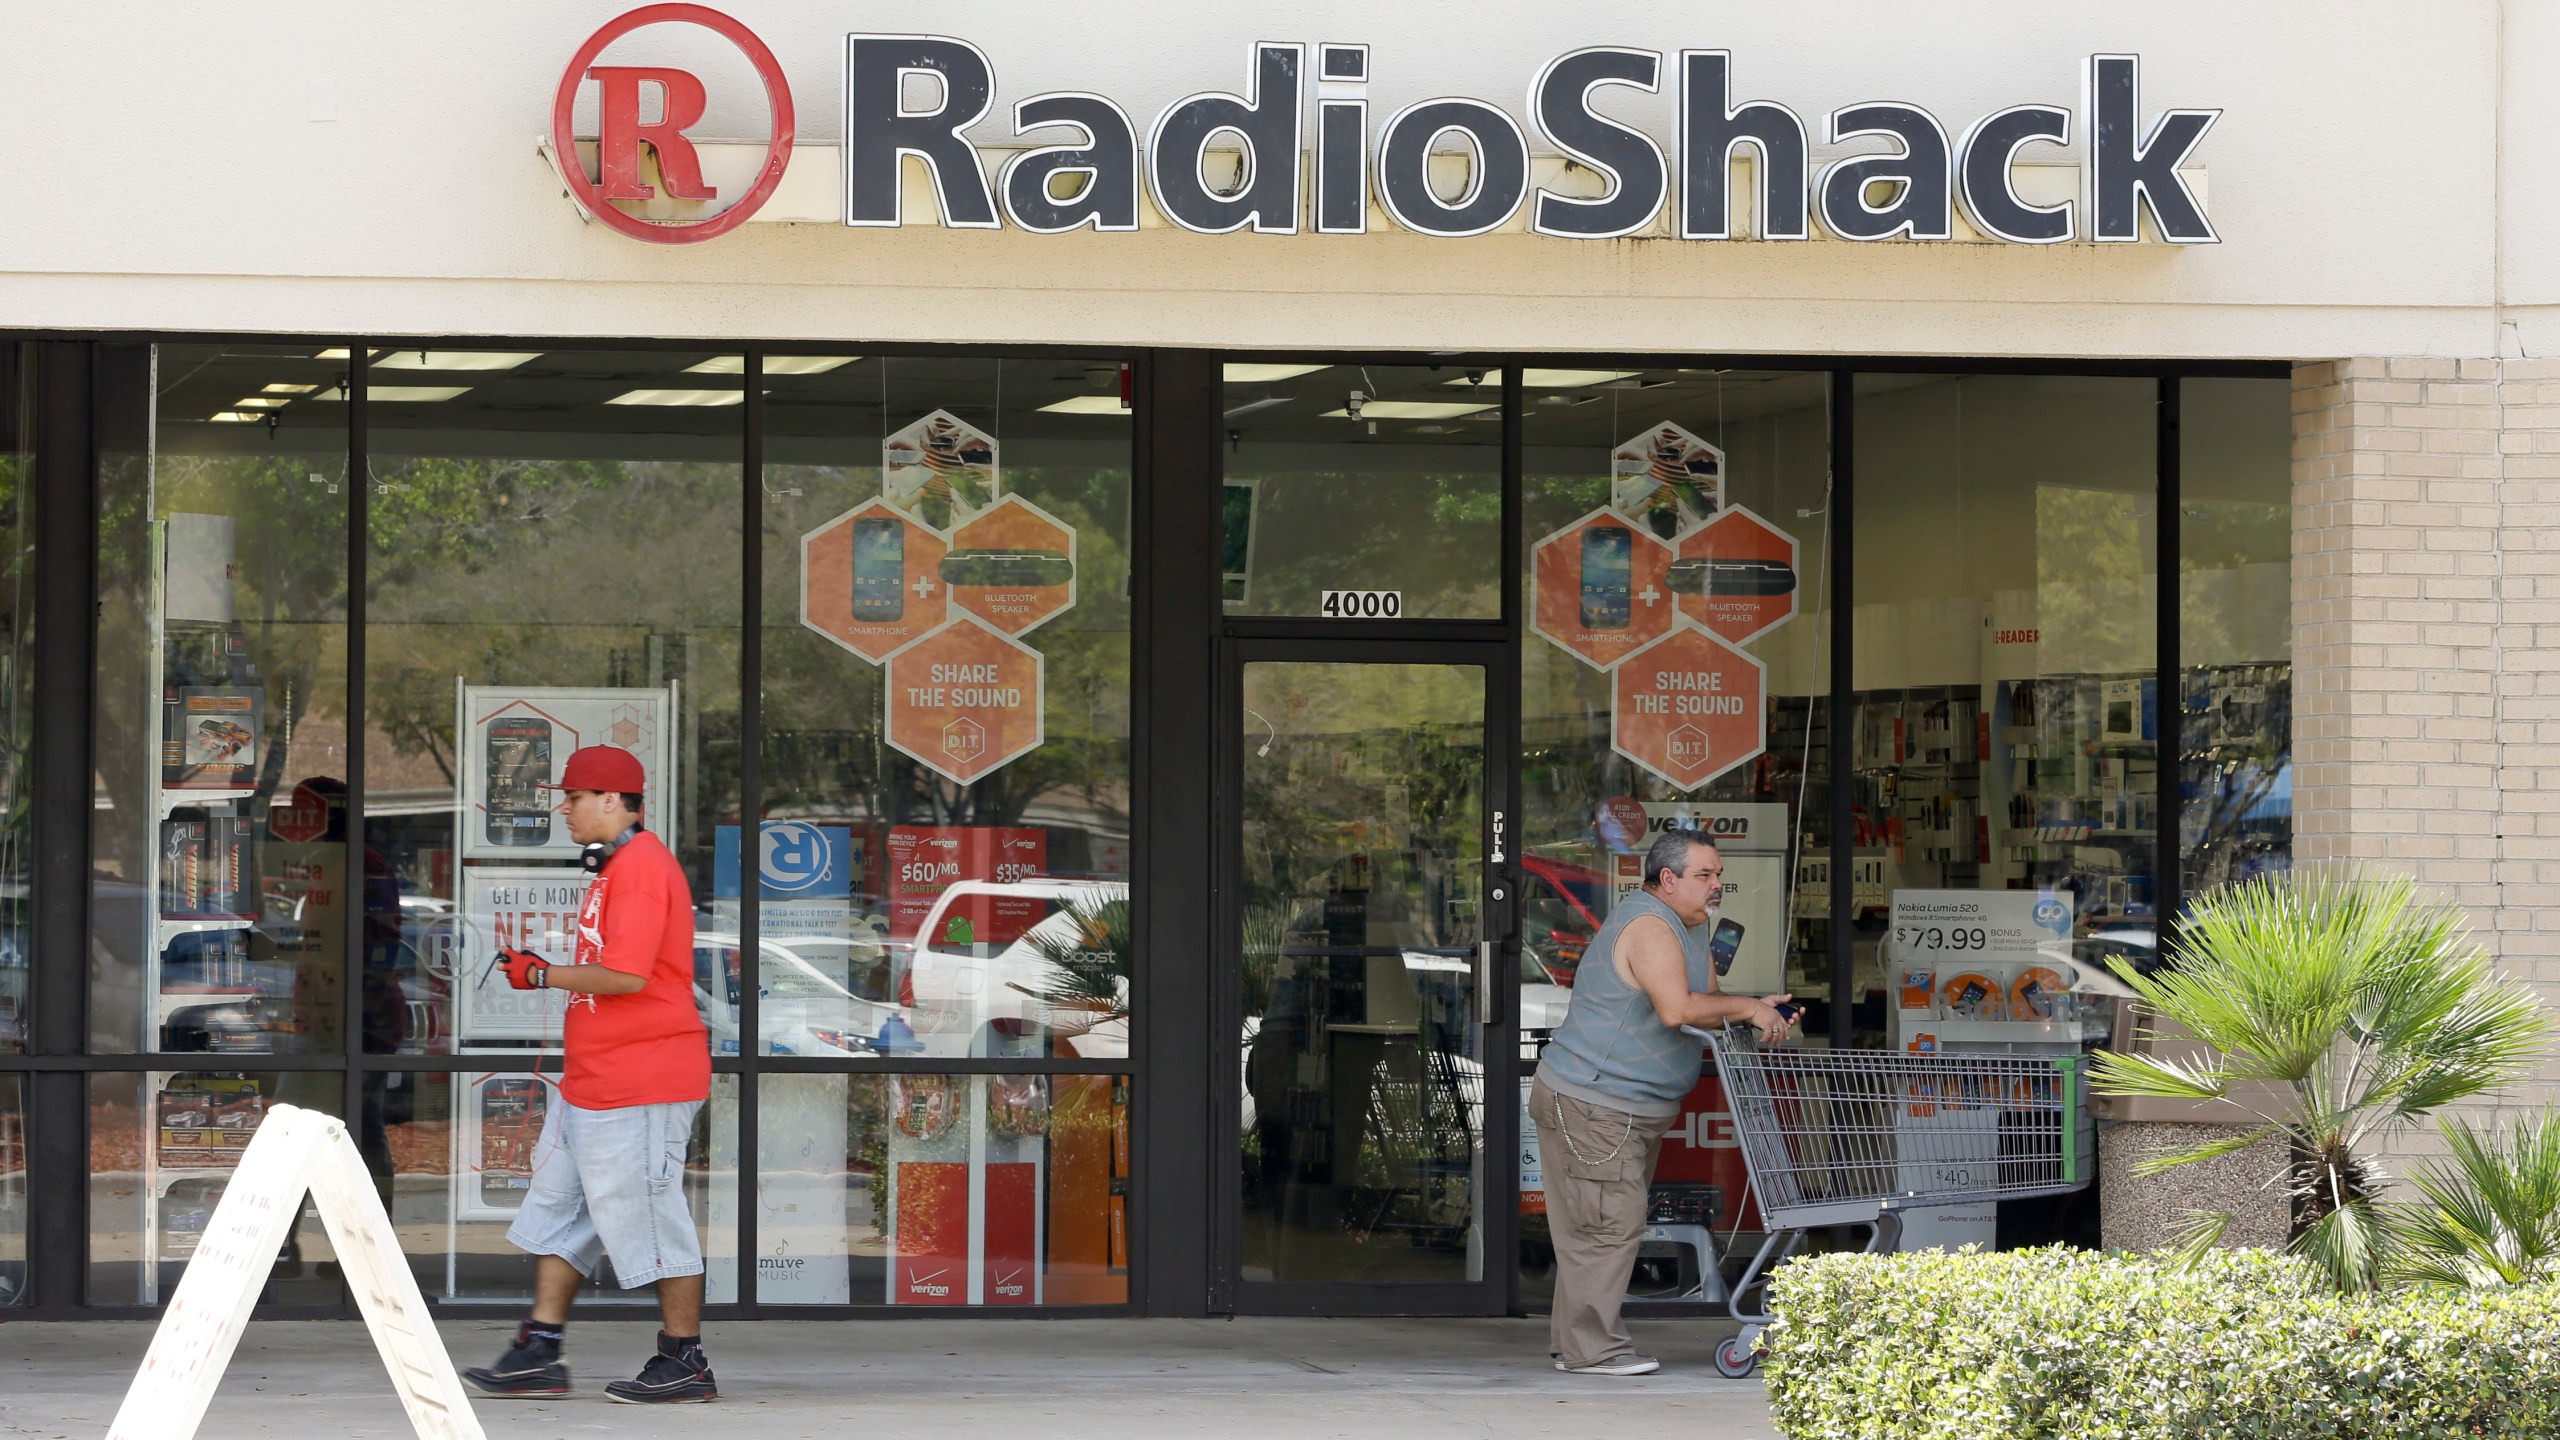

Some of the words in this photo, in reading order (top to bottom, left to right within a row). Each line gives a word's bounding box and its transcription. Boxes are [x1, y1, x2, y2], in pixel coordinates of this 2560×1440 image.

[842, 32, 2224, 245] RadioShack
[985, 594, 1036, 602] BLUETOOTH
[1323, 592, 1400, 617] 4000
[992, 605, 1029, 613] SPEAKER
[1709, 603, 1760, 612] BLUETOOTH
[1716, 614, 1752, 622] SPEAKER
[848, 627, 908, 636] SMARTPHONE
[1576, 634, 1634, 643] SMARTPHONE
[931, 664, 998, 684] SHARE
[1656, 672, 1721, 691] SHARE
[907, 688, 945, 707] THE
[951, 688, 1021, 708] SOUND
[1633, 695, 1669, 714] THE
[1675, 695, 1744, 715] SOUND
[1672, 741, 1702, 755] D.I.T.
[1648, 812, 1748, 839] verizon
[930, 839, 957, 848] verizon
[1017, 840, 1036, 849] verizon
[902, 862, 961, 882] $60/MO.
[997, 863, 1038, 883] $35/MO.
[901, 884, 948, 893] SMARTPHO
[1721, 884, 1738, 892] TER
[493, 887, 520, 905] GET
[529, 887, 537, 905] 6
[546, 887, 589, 905] MONT
[761, 909, 788, 917] LIMITED
[1898, 903, 1926, 912] Nokia
[1927, 903, 1957, 912] Lumia
[1959, 904, 1979, 912] 520
[2037, 904, 2063, 922] go
[494, 911, 578, 953] NETF
[1991, 929, 2022, 937] BONUS
[759, 1258, 805, 1269] muve
[911, 1283, 949, 1296] verizon
[996, 1283, 1023, 1296] verizon
